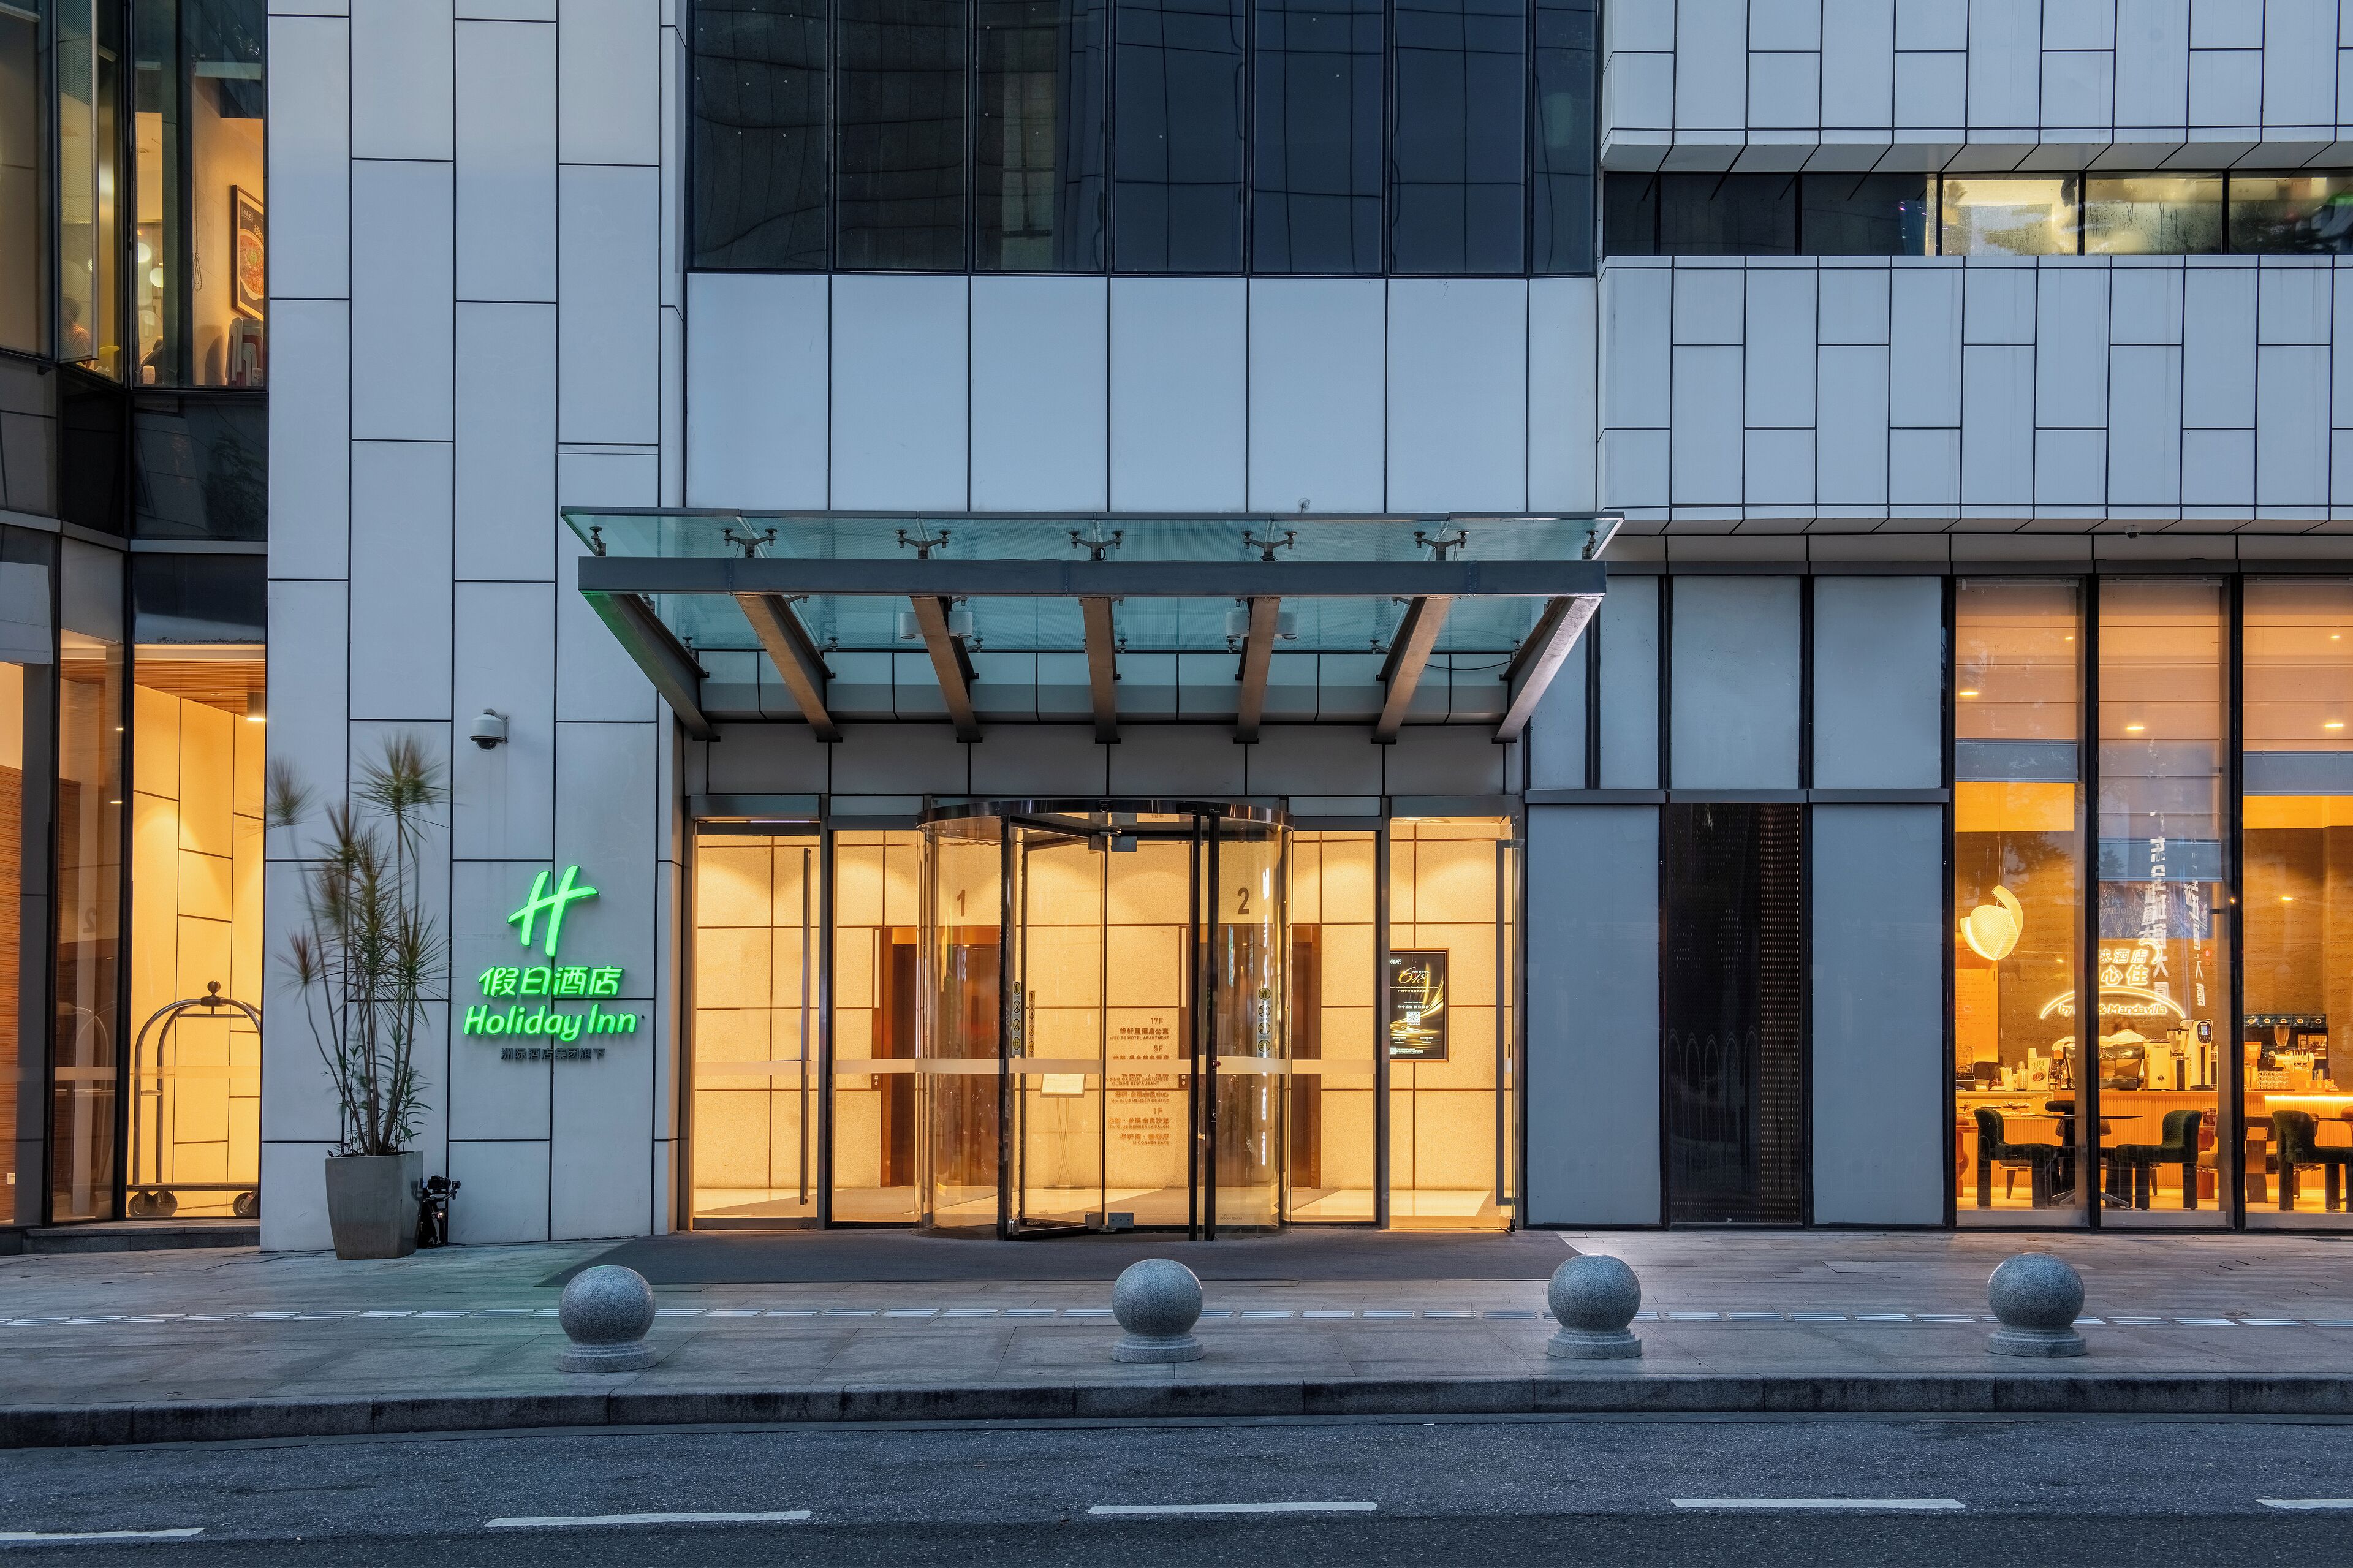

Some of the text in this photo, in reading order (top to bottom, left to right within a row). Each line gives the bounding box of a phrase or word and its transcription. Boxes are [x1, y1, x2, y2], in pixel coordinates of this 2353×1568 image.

[957, 889, 966, 917] 1
[1237, 887, 1250, 915] 2
[478, 965, 625, 997] 假日酒店
[1398, 966, 1429, 984] 618
[464, 1004, 638, 1042] Holiday Inn
[2059, 1004, 2073, 1016] by
[2109, 1004, 2167, 1015] Mandavilla
[501, 1047, 605, 1060] 洲际酒店集团旗下
